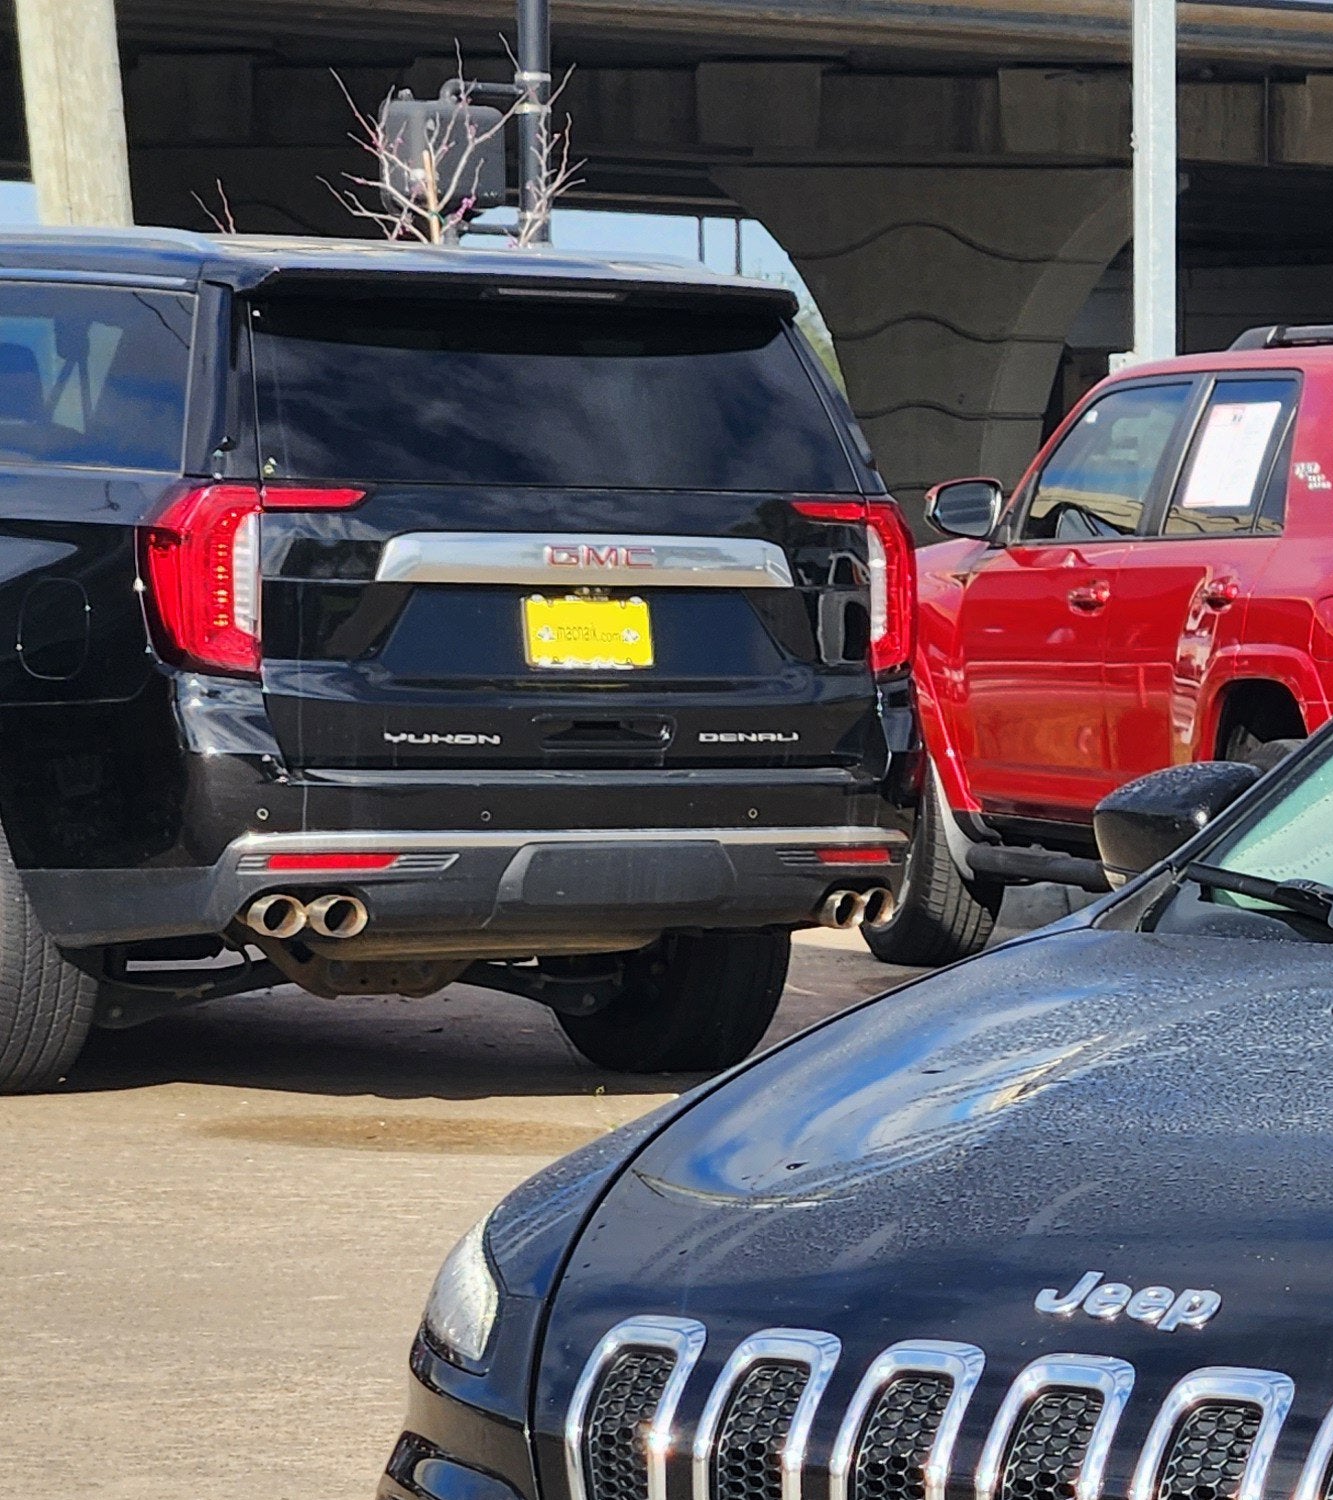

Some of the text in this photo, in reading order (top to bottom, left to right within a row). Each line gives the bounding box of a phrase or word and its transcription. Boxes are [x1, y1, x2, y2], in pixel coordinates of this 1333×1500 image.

[543, 545, 655, 569] GMC
[383, 732, 501, 745] YUKON
[699, 732, 799, 743] DENALI
[1034, 1270, 1223, 1333] Jeep
